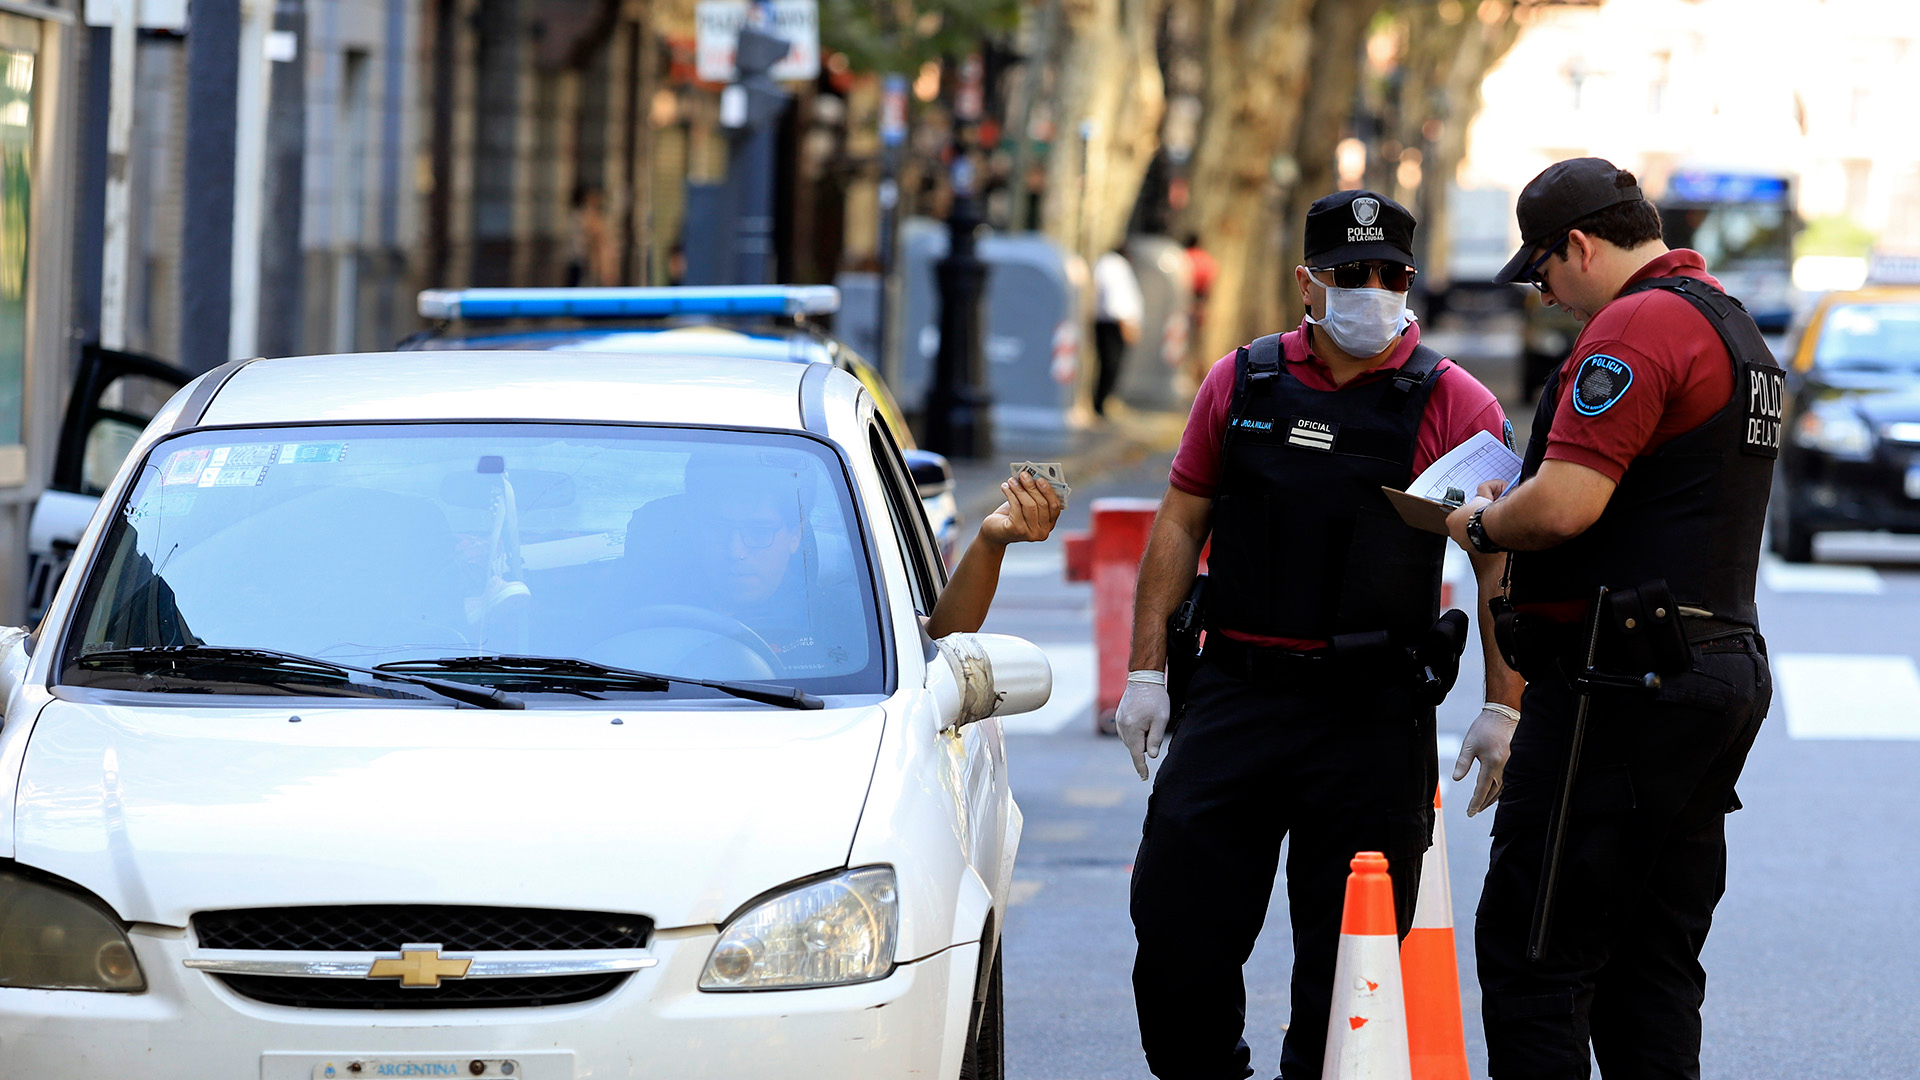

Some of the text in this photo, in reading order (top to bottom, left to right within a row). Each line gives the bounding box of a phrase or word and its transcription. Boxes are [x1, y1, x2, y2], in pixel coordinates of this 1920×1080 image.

[1347, 227, 1384, 236] POLICIA
[1591, 357, 1623, 375] POLICIA
[1297, 419, 1331, 433] OFICIAL
[1747, 418, 1761, 444] DE
[1761, 420, 1772, 446] LA
[376, 1063, 458, 1076] ARGENTINA
